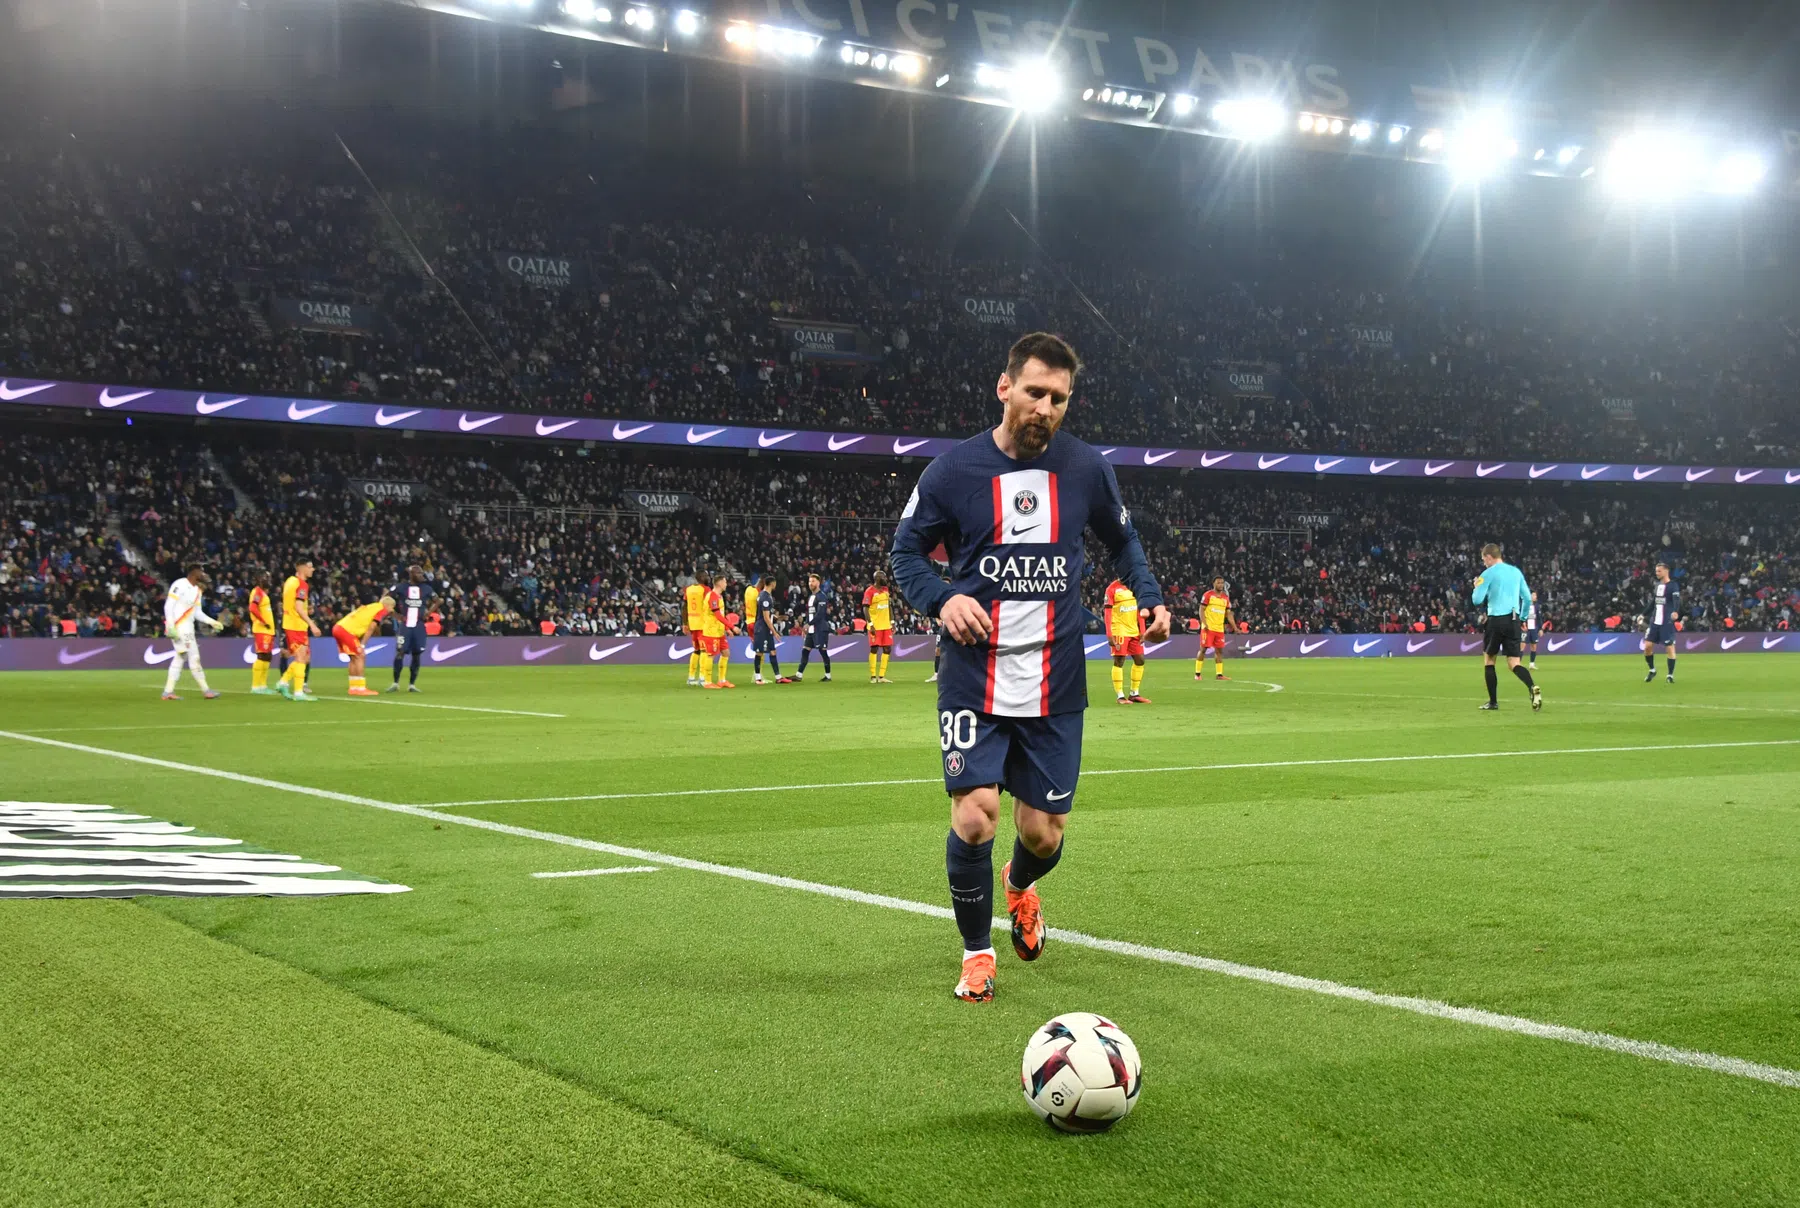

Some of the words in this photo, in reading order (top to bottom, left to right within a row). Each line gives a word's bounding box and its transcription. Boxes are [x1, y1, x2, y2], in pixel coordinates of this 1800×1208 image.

[1134, 37, 1349, 109] PARIS
[507, 255, 571, 277] QATAR
[299, 301, 352, 318] QATAR
[964, 298, 1016, 315] QATAR
[794, 330, 835, 343] QATAR
[1229, 373, 1264, 385] QATAR
[364, 483, 412, 496] QATAR
[638, 494, 680, 507] QATAR
[979, 556, 1068, 583] QATAR
[1001, 578, 1068, 594] AIRWAYS
[940, 709, 977, 752] 30
